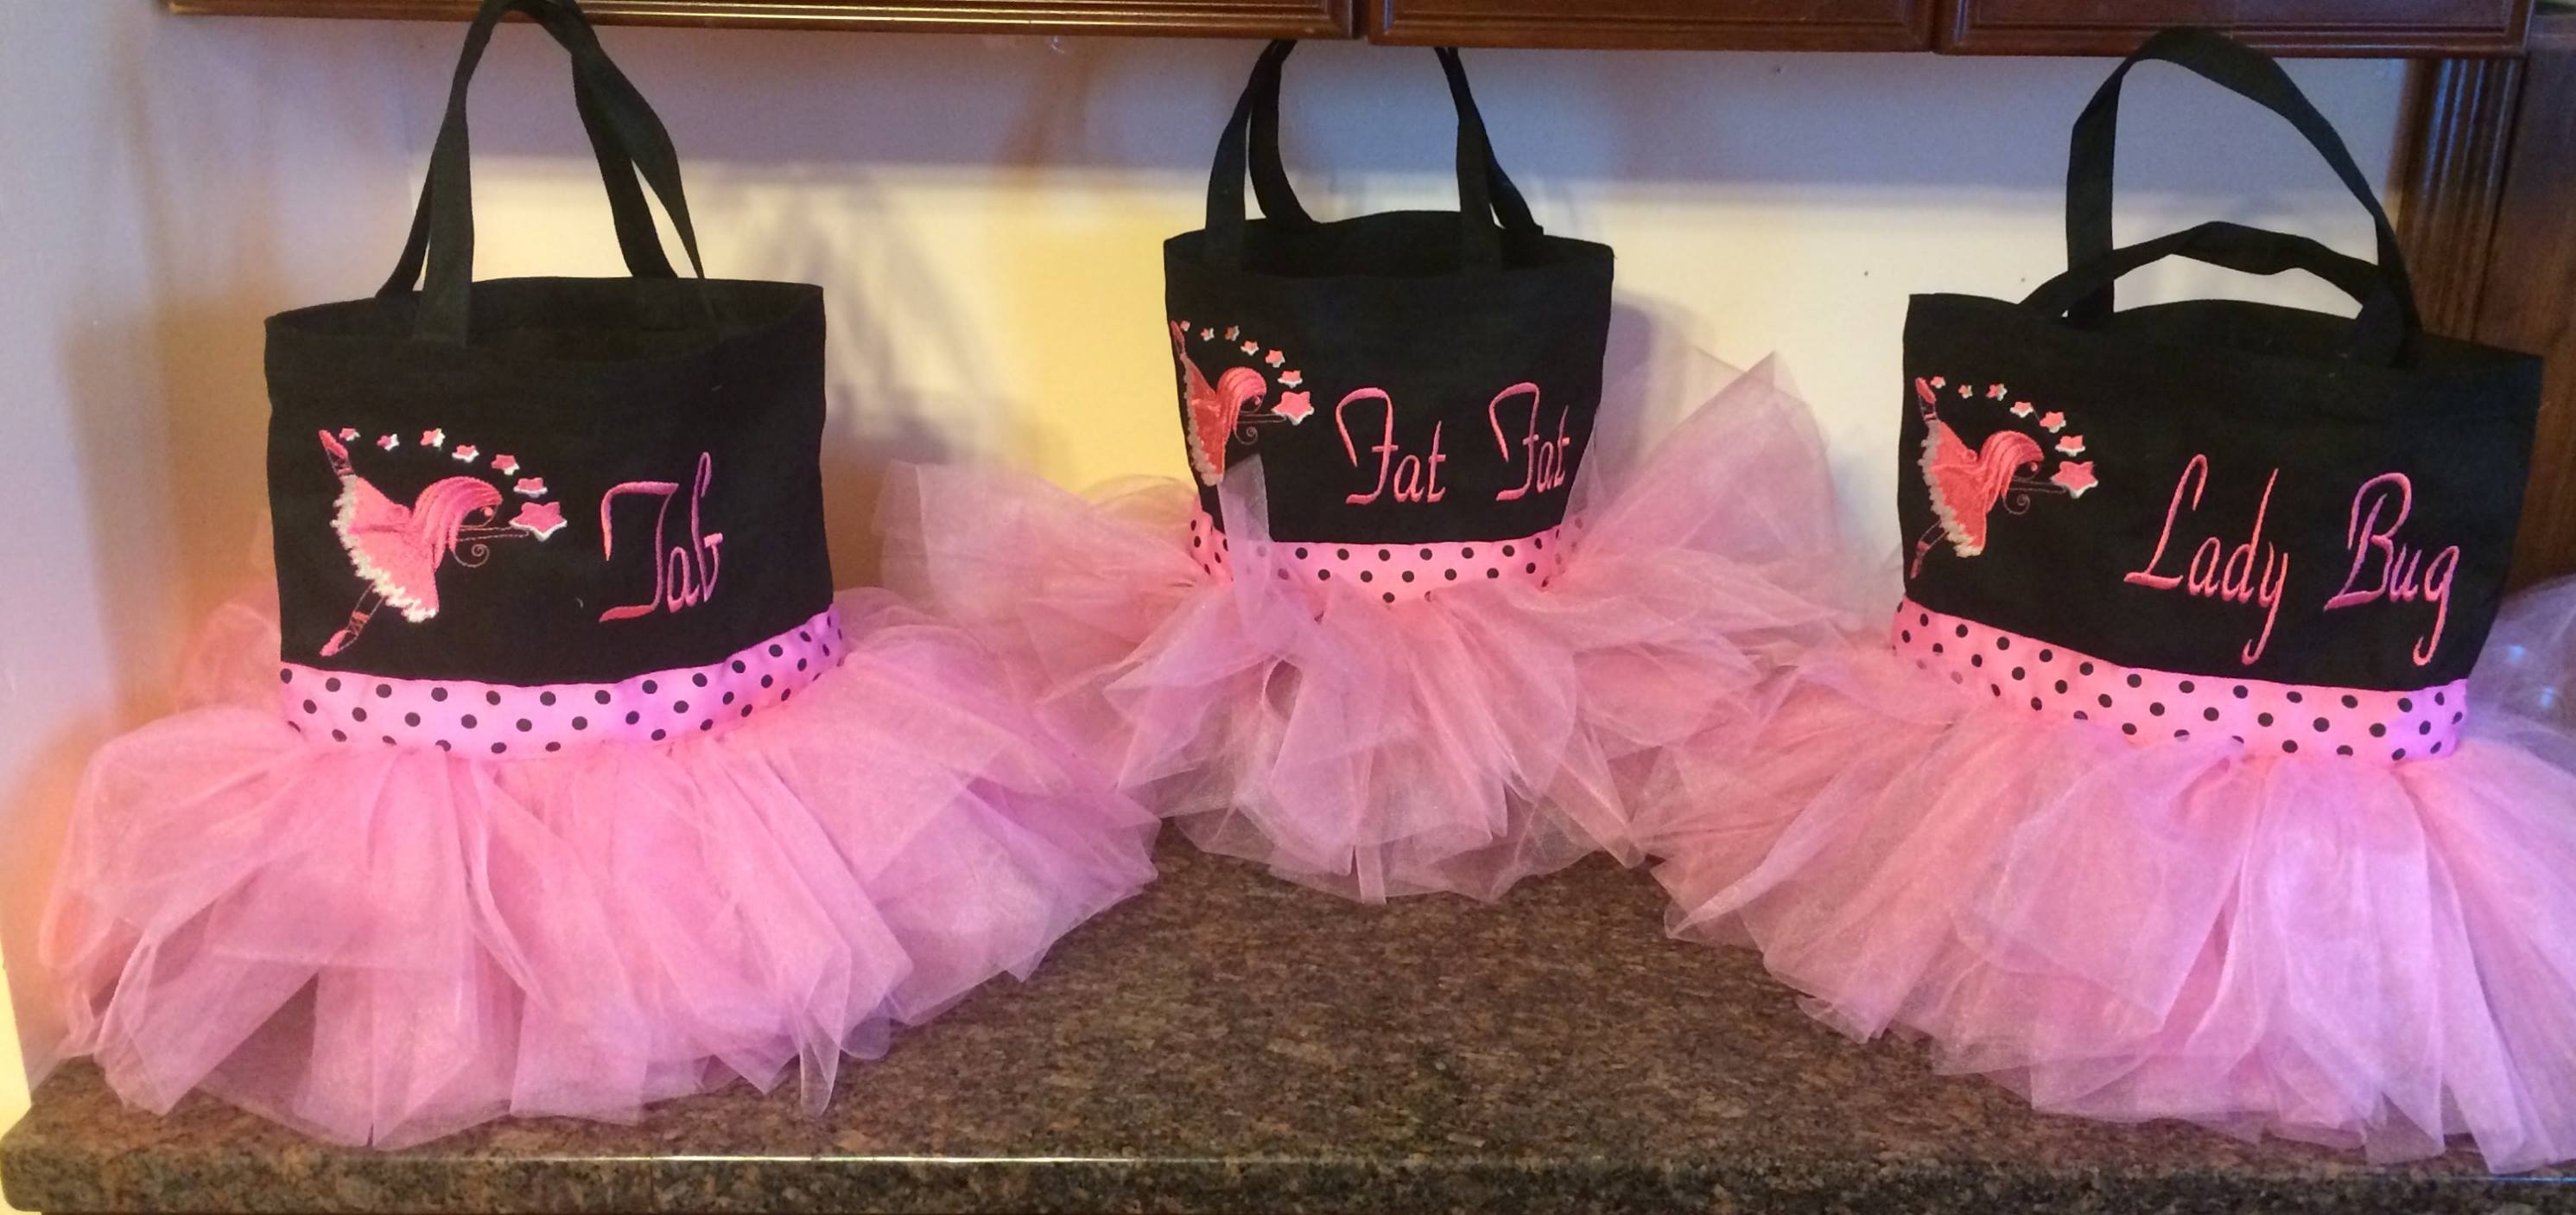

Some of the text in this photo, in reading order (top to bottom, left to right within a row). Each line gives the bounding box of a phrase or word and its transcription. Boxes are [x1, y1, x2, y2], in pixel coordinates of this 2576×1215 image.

[1335, 381, 1570, 506] Fat Fat
[599, 451, 724, 623] Tab
[2123, 454, 2460, 666] Lady Bug
